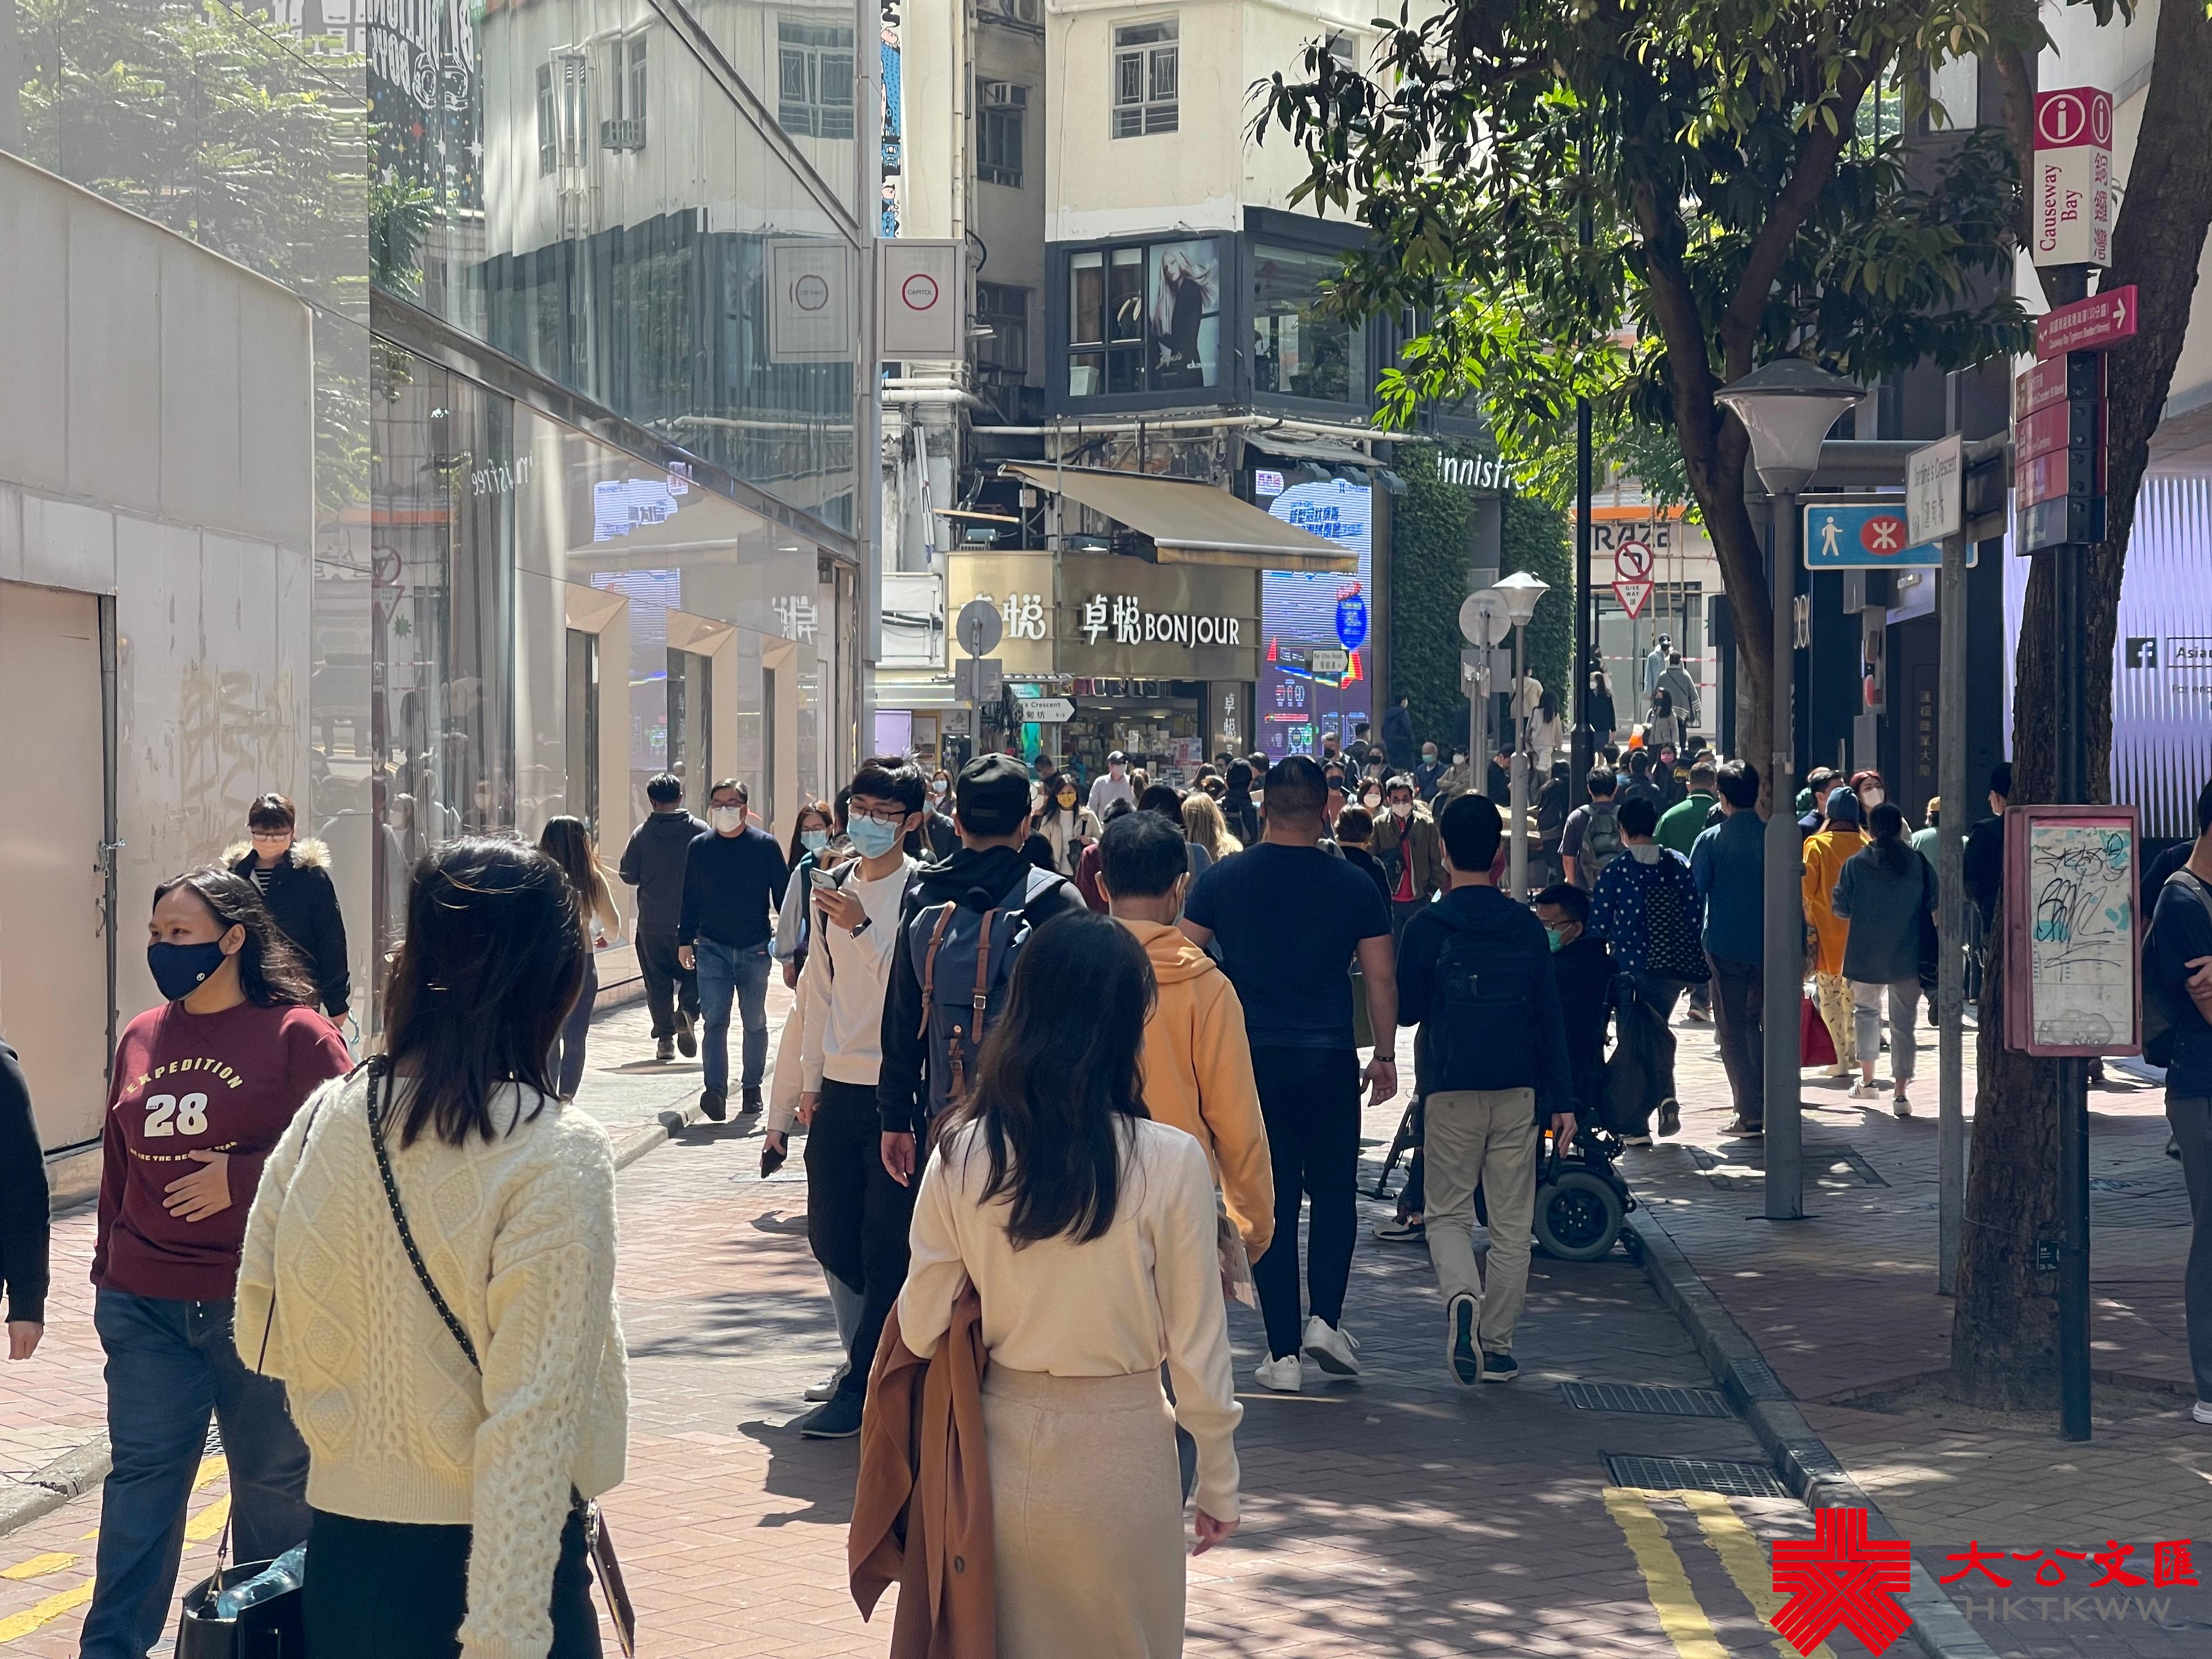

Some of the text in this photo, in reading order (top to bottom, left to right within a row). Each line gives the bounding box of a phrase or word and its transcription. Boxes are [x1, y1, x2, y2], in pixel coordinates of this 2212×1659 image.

[2040, 165, 2062, 252] Causeway
[2061, 190, 2083, 222] Bay
[2094, 152, 2108, 261] 銅鑼灣
[1145, 613, 1239, 648] BONJOUR
[1026, 710, 1045, 719] 甸坊
[127, 1058, 243, 1093] EXPEDITION
[144, 1093, 208, 1137] 28
